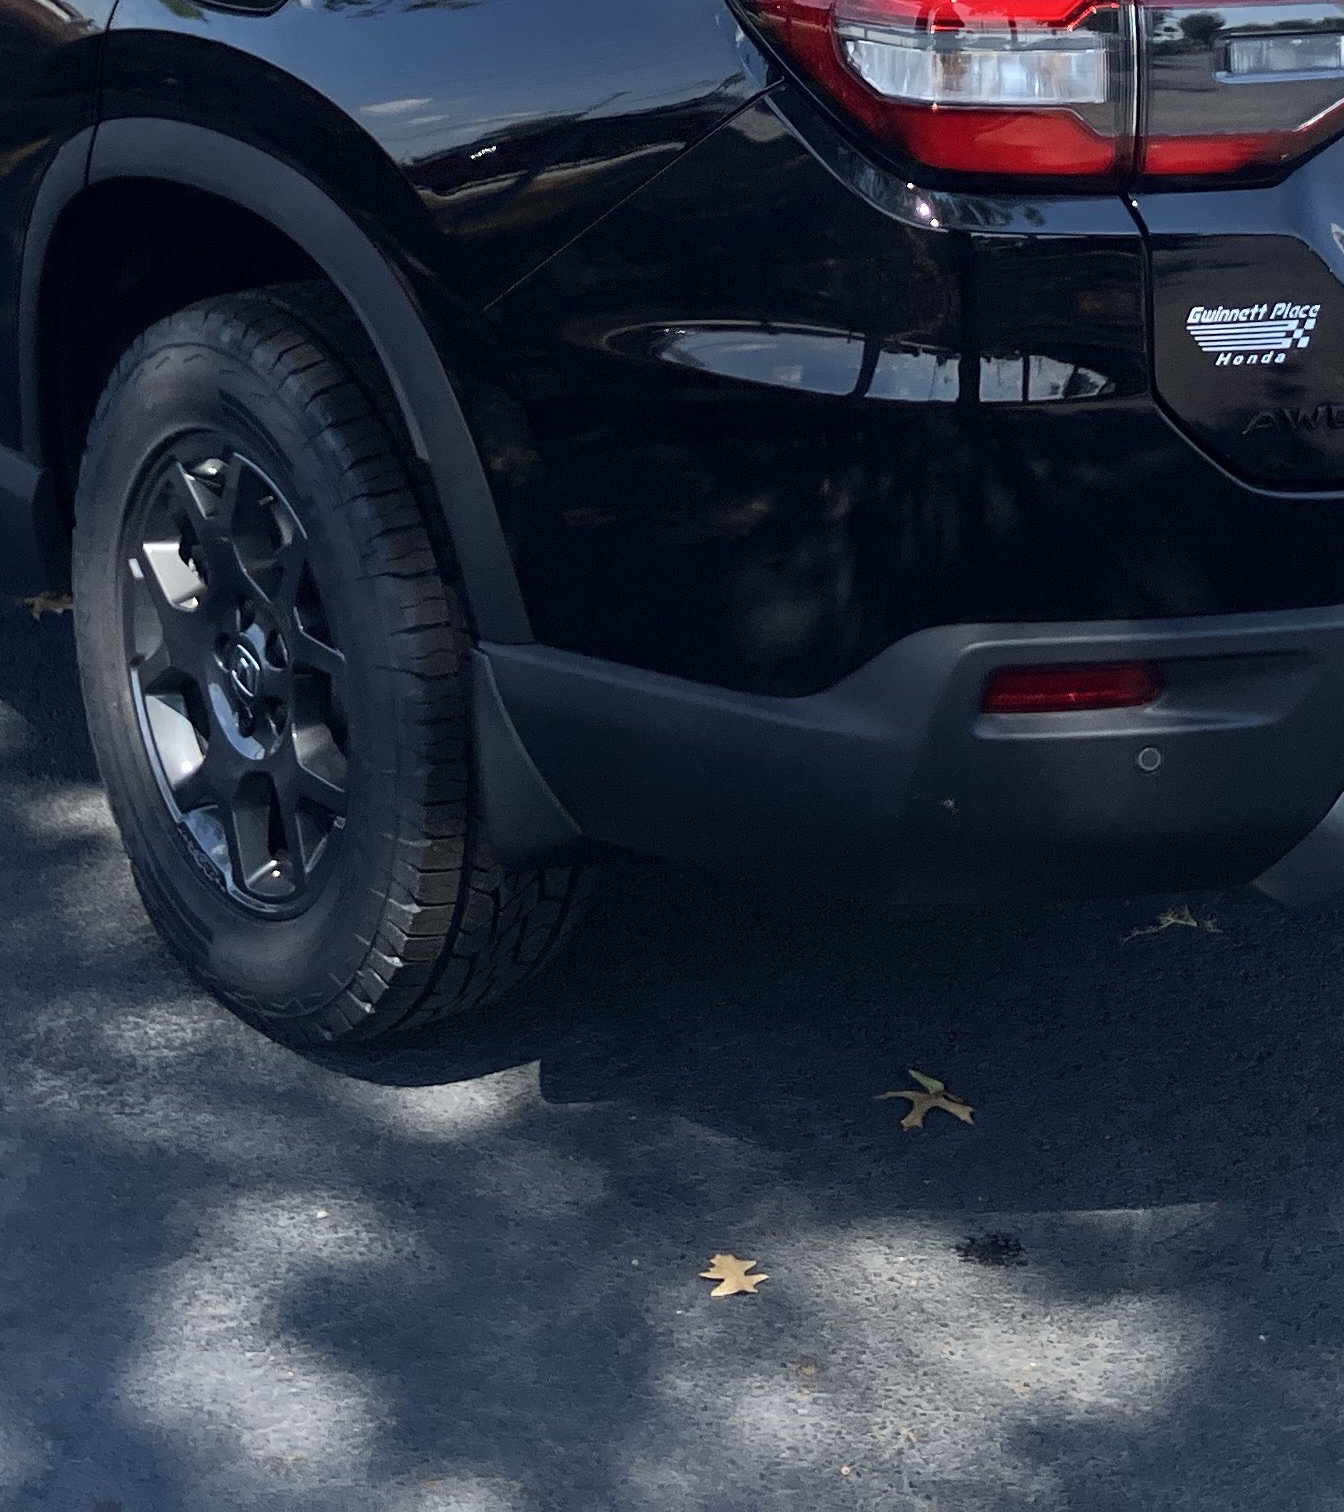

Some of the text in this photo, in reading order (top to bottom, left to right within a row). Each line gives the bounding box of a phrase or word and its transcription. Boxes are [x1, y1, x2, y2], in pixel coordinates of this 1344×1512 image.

[1186, 302, 1321, 324] Gwinnett Place
[1215, 351, 1286, 366] Honda
